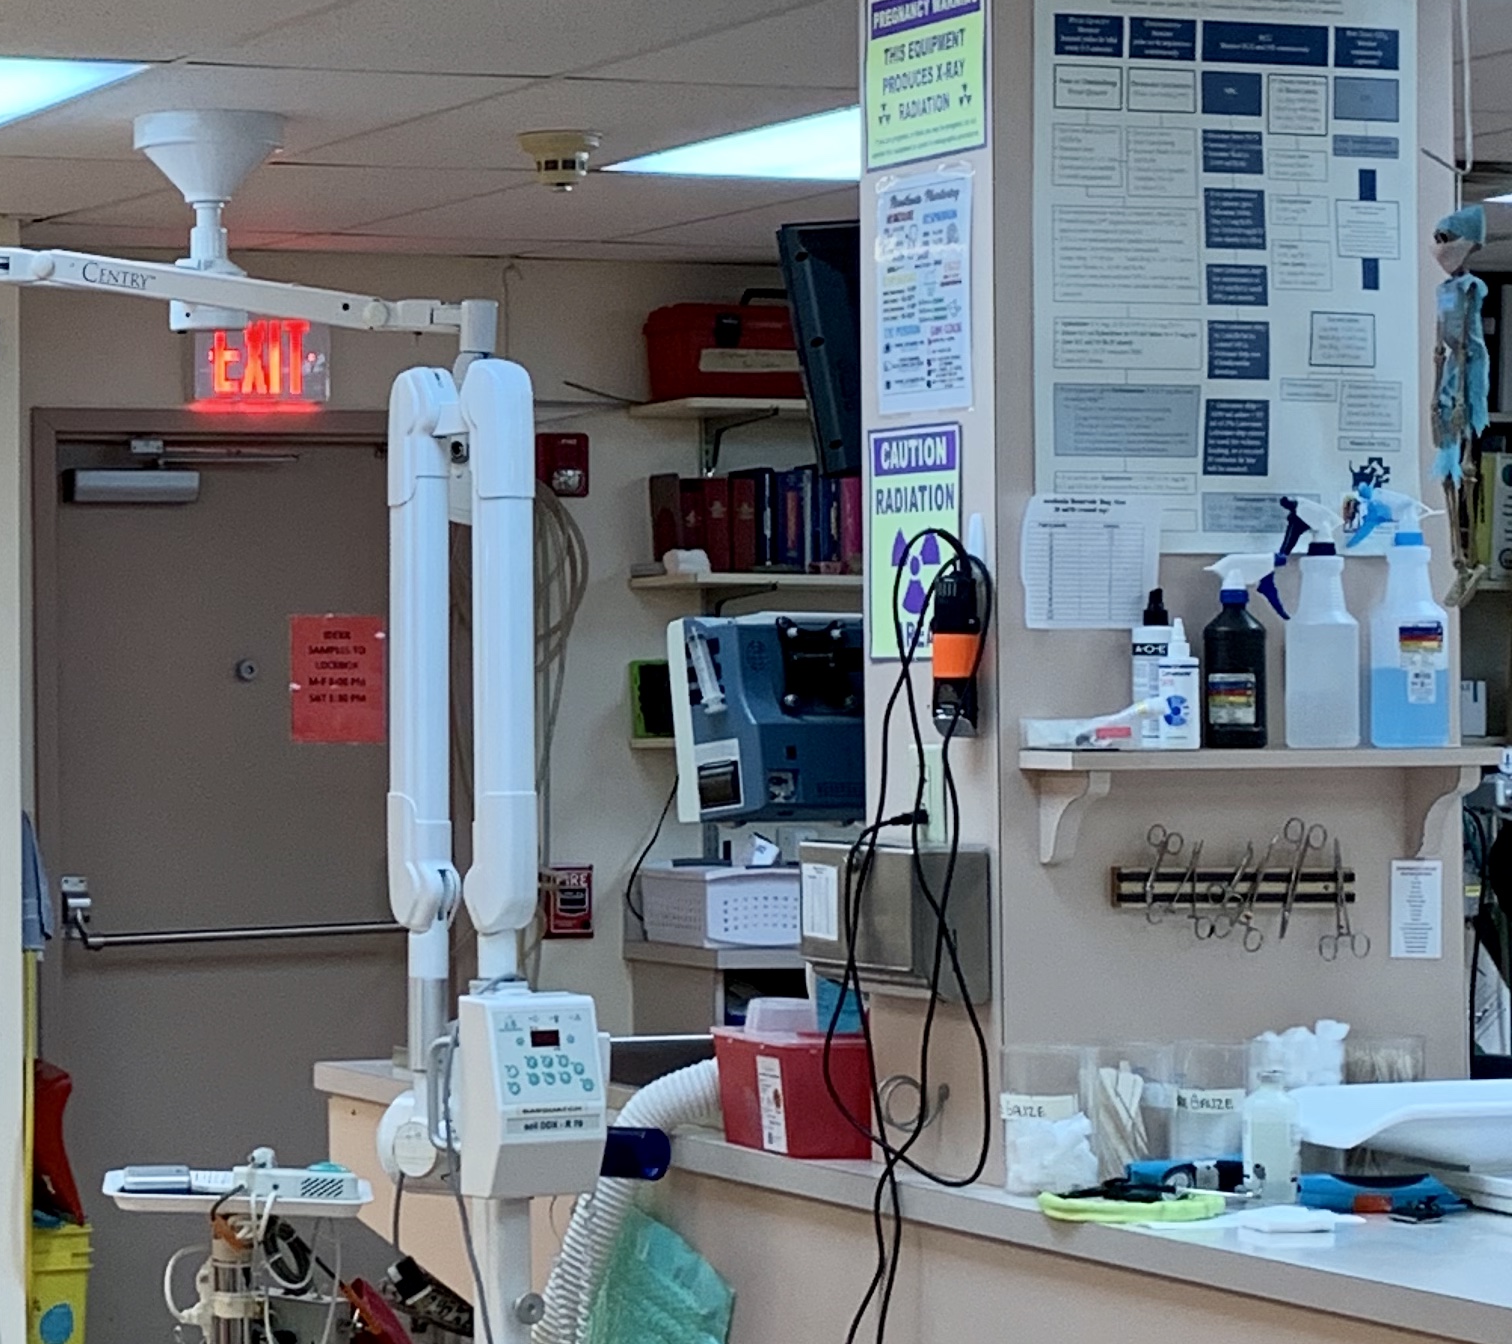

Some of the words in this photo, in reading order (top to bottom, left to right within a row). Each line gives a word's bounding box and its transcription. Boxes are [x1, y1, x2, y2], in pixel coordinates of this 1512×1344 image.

[883, 43, 906, 65] THIS
[908, 28, 966, 60] EQUIPMENT
[882, 66, 933, 96] PRODUCES
[936, 58, 966, 83] X-RAY
[898, 93, 950, 121] RADIATION
[213, 320, 311, 395] EXIT
[880, 435, 948, 471] CAUTION
[875, 482, 955, 515] RADIATION
[353, 645, 366, 655] TO
[351, 677, 366, 686] PM
[351, 694, 366, 703] PM
